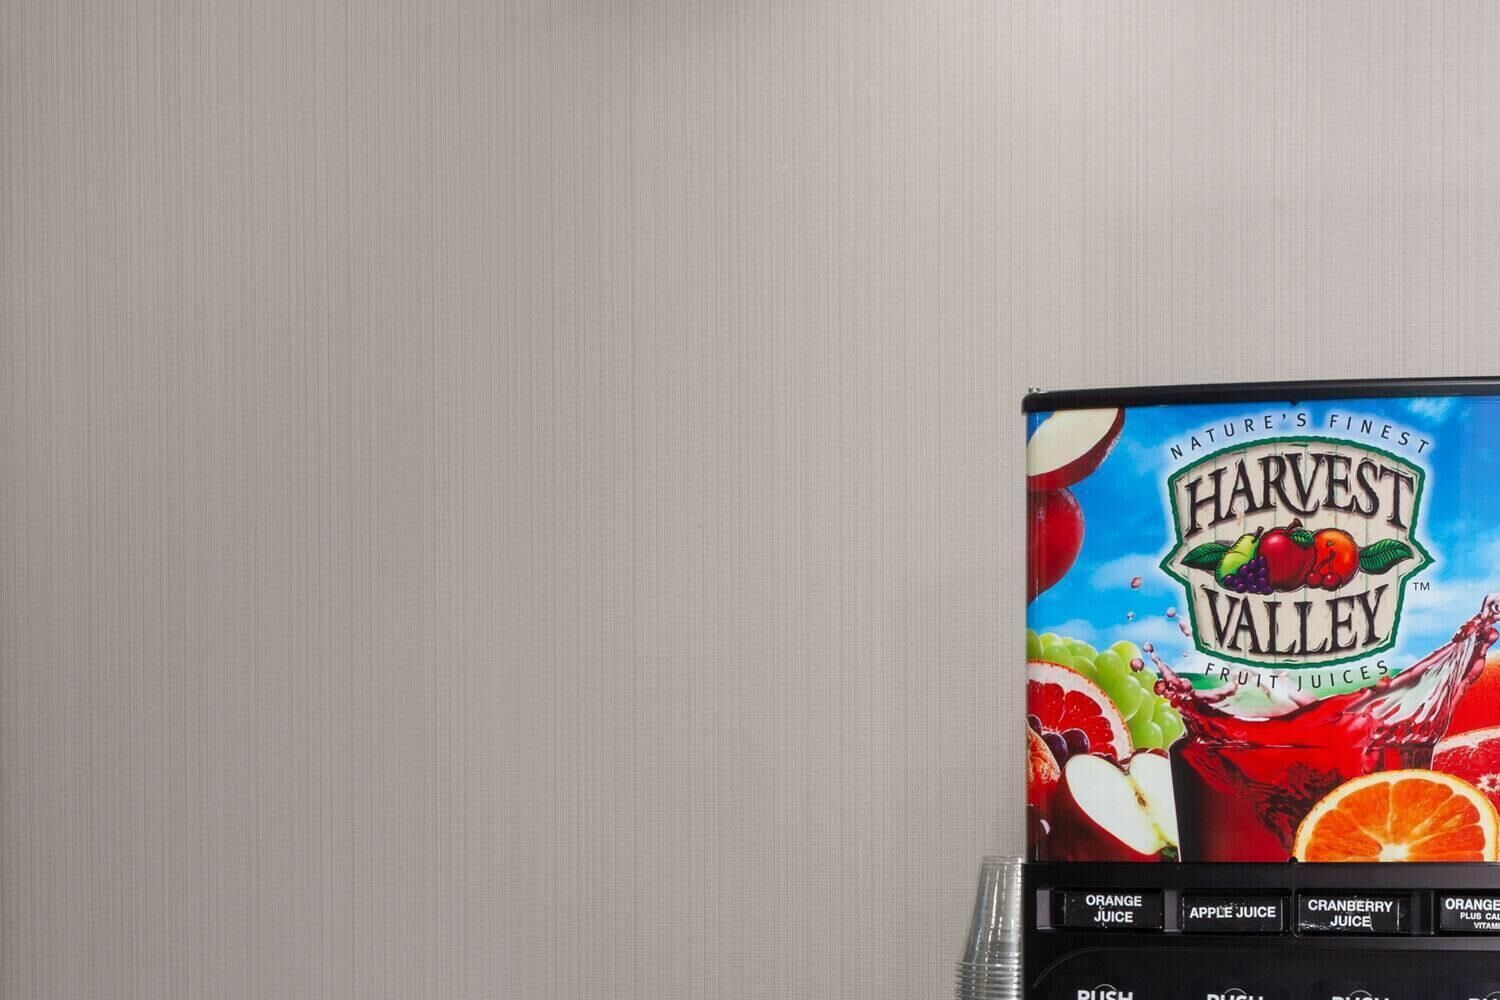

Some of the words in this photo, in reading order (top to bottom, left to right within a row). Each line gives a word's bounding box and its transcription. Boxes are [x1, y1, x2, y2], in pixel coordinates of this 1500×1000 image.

[1170, 413, 1307, 460] NATURE'S
[1329, 414, 1429, 454] FINEST
[1184, 452, 1414, 538] HARVEST
[1413, 581, 1430, 591] TM
[1200, 584, 1389, 656] VALLEY
[1205, 662, 1280, 689] FRUIT
[1298, 659, 1389, 691] JUICES
[1086, 895, 1142, 907] ORANGE
[1308, 899, 1393, 913] CRANBERRY
[1445, 898, 1500, 911] ORANGE
[1094, 911, 1133, 923] JUICE
[1189, 907, 1233, 918] APPLE
[1236, 906, 1276, 918] JUICE
[1460, 912, 1482, 920] PLUS
[1330, 915, 1371, 927] JUICE
